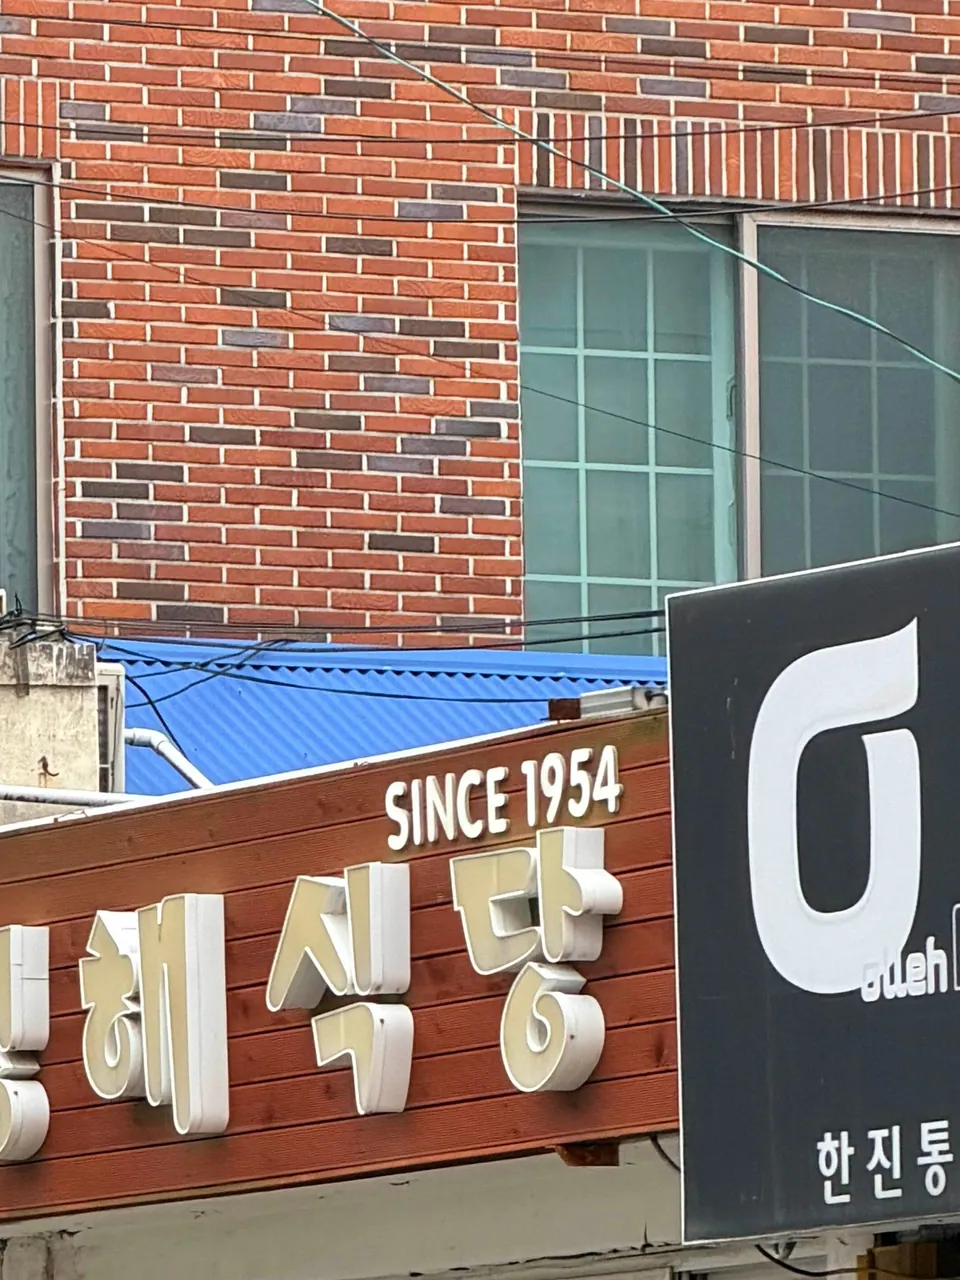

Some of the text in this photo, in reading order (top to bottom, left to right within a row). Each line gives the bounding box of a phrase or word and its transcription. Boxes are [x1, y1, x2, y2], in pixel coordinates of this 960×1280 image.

[386, 745, 623, 850] SINCE 1954
[861, 936, 948, 1002] olleh
